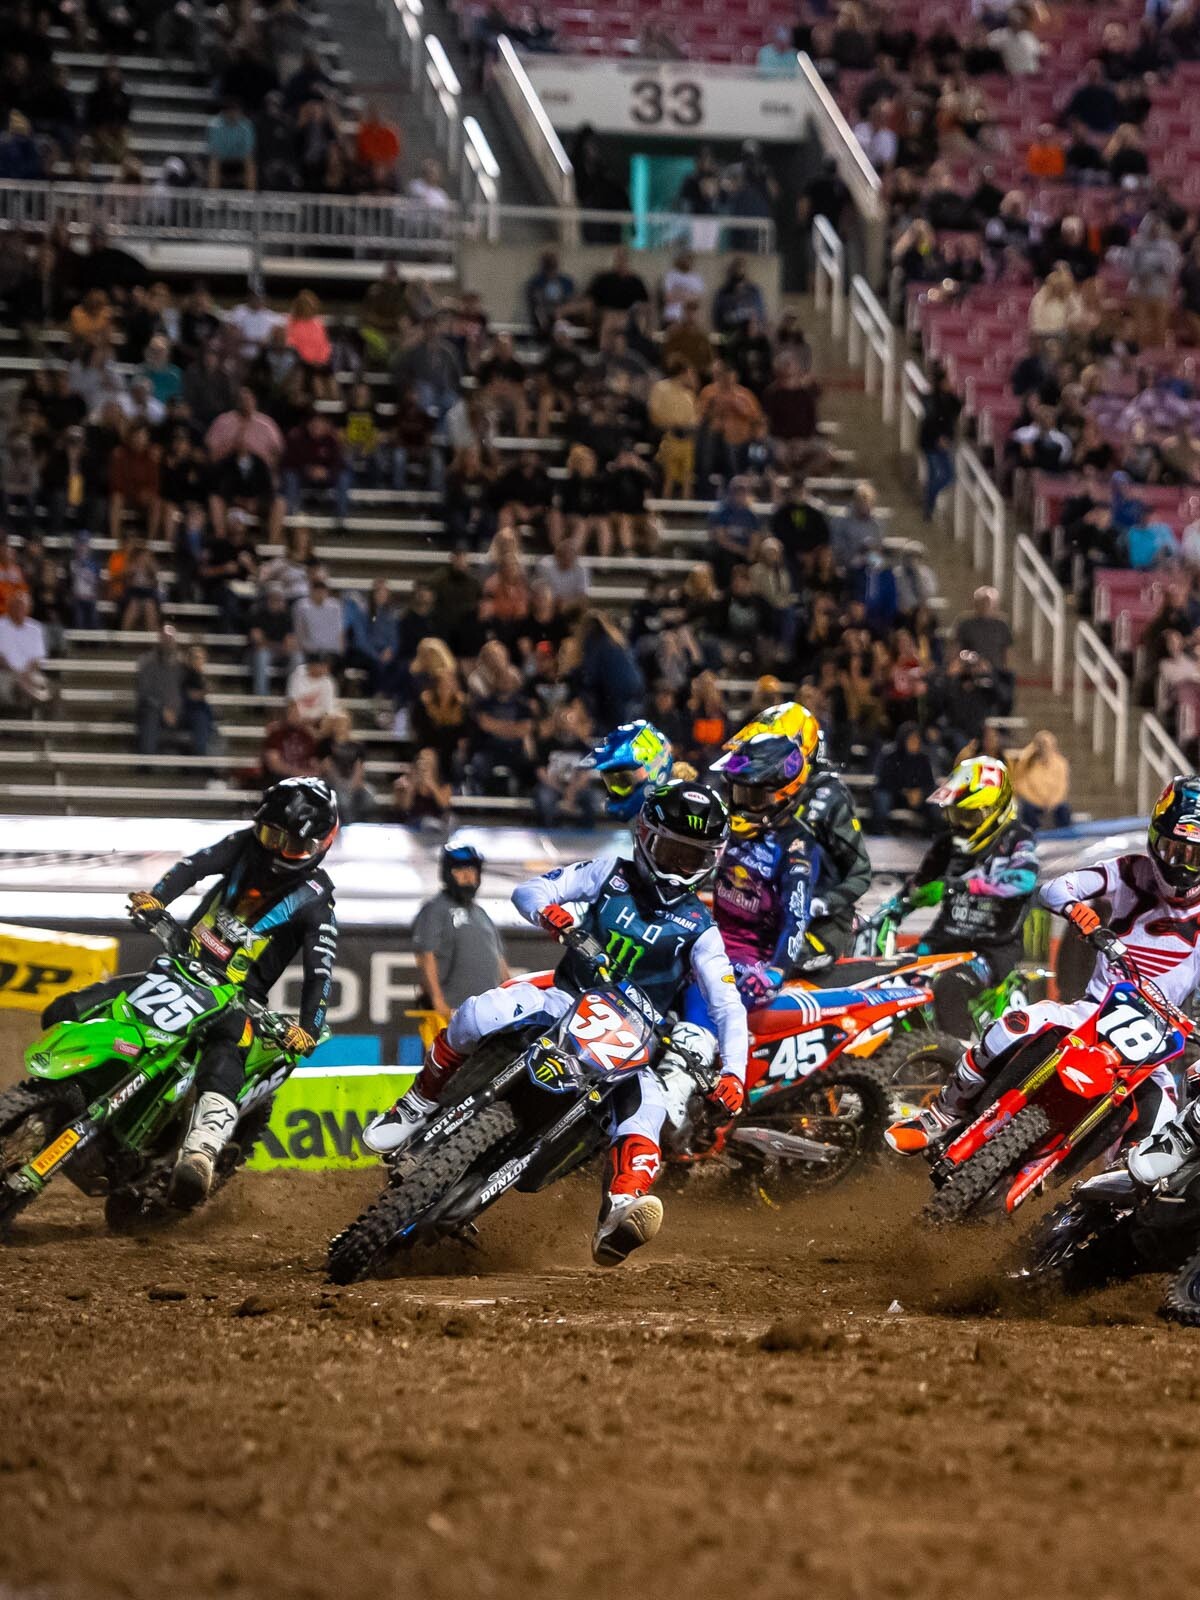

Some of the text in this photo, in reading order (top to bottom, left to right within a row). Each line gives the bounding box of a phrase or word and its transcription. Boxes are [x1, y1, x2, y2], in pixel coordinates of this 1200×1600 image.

[630, 80, 703, 127] 33
[664, 910, 697, 932] YAMAHA
[126, 973, 206, 1032] 125
[568, 1002, 645, 1071] 32
[769, 1028, 827, 1080] 45
[1096, 1004, 1167, 1062] 18
[424, 1096, 475, 1142] DUNLOP
[480, 1154, 531, 1204] DUNLOP
[499, 1158, 519, 1177] CYCRA
[1014, 1158, 1060, 1207] DUNLOP
